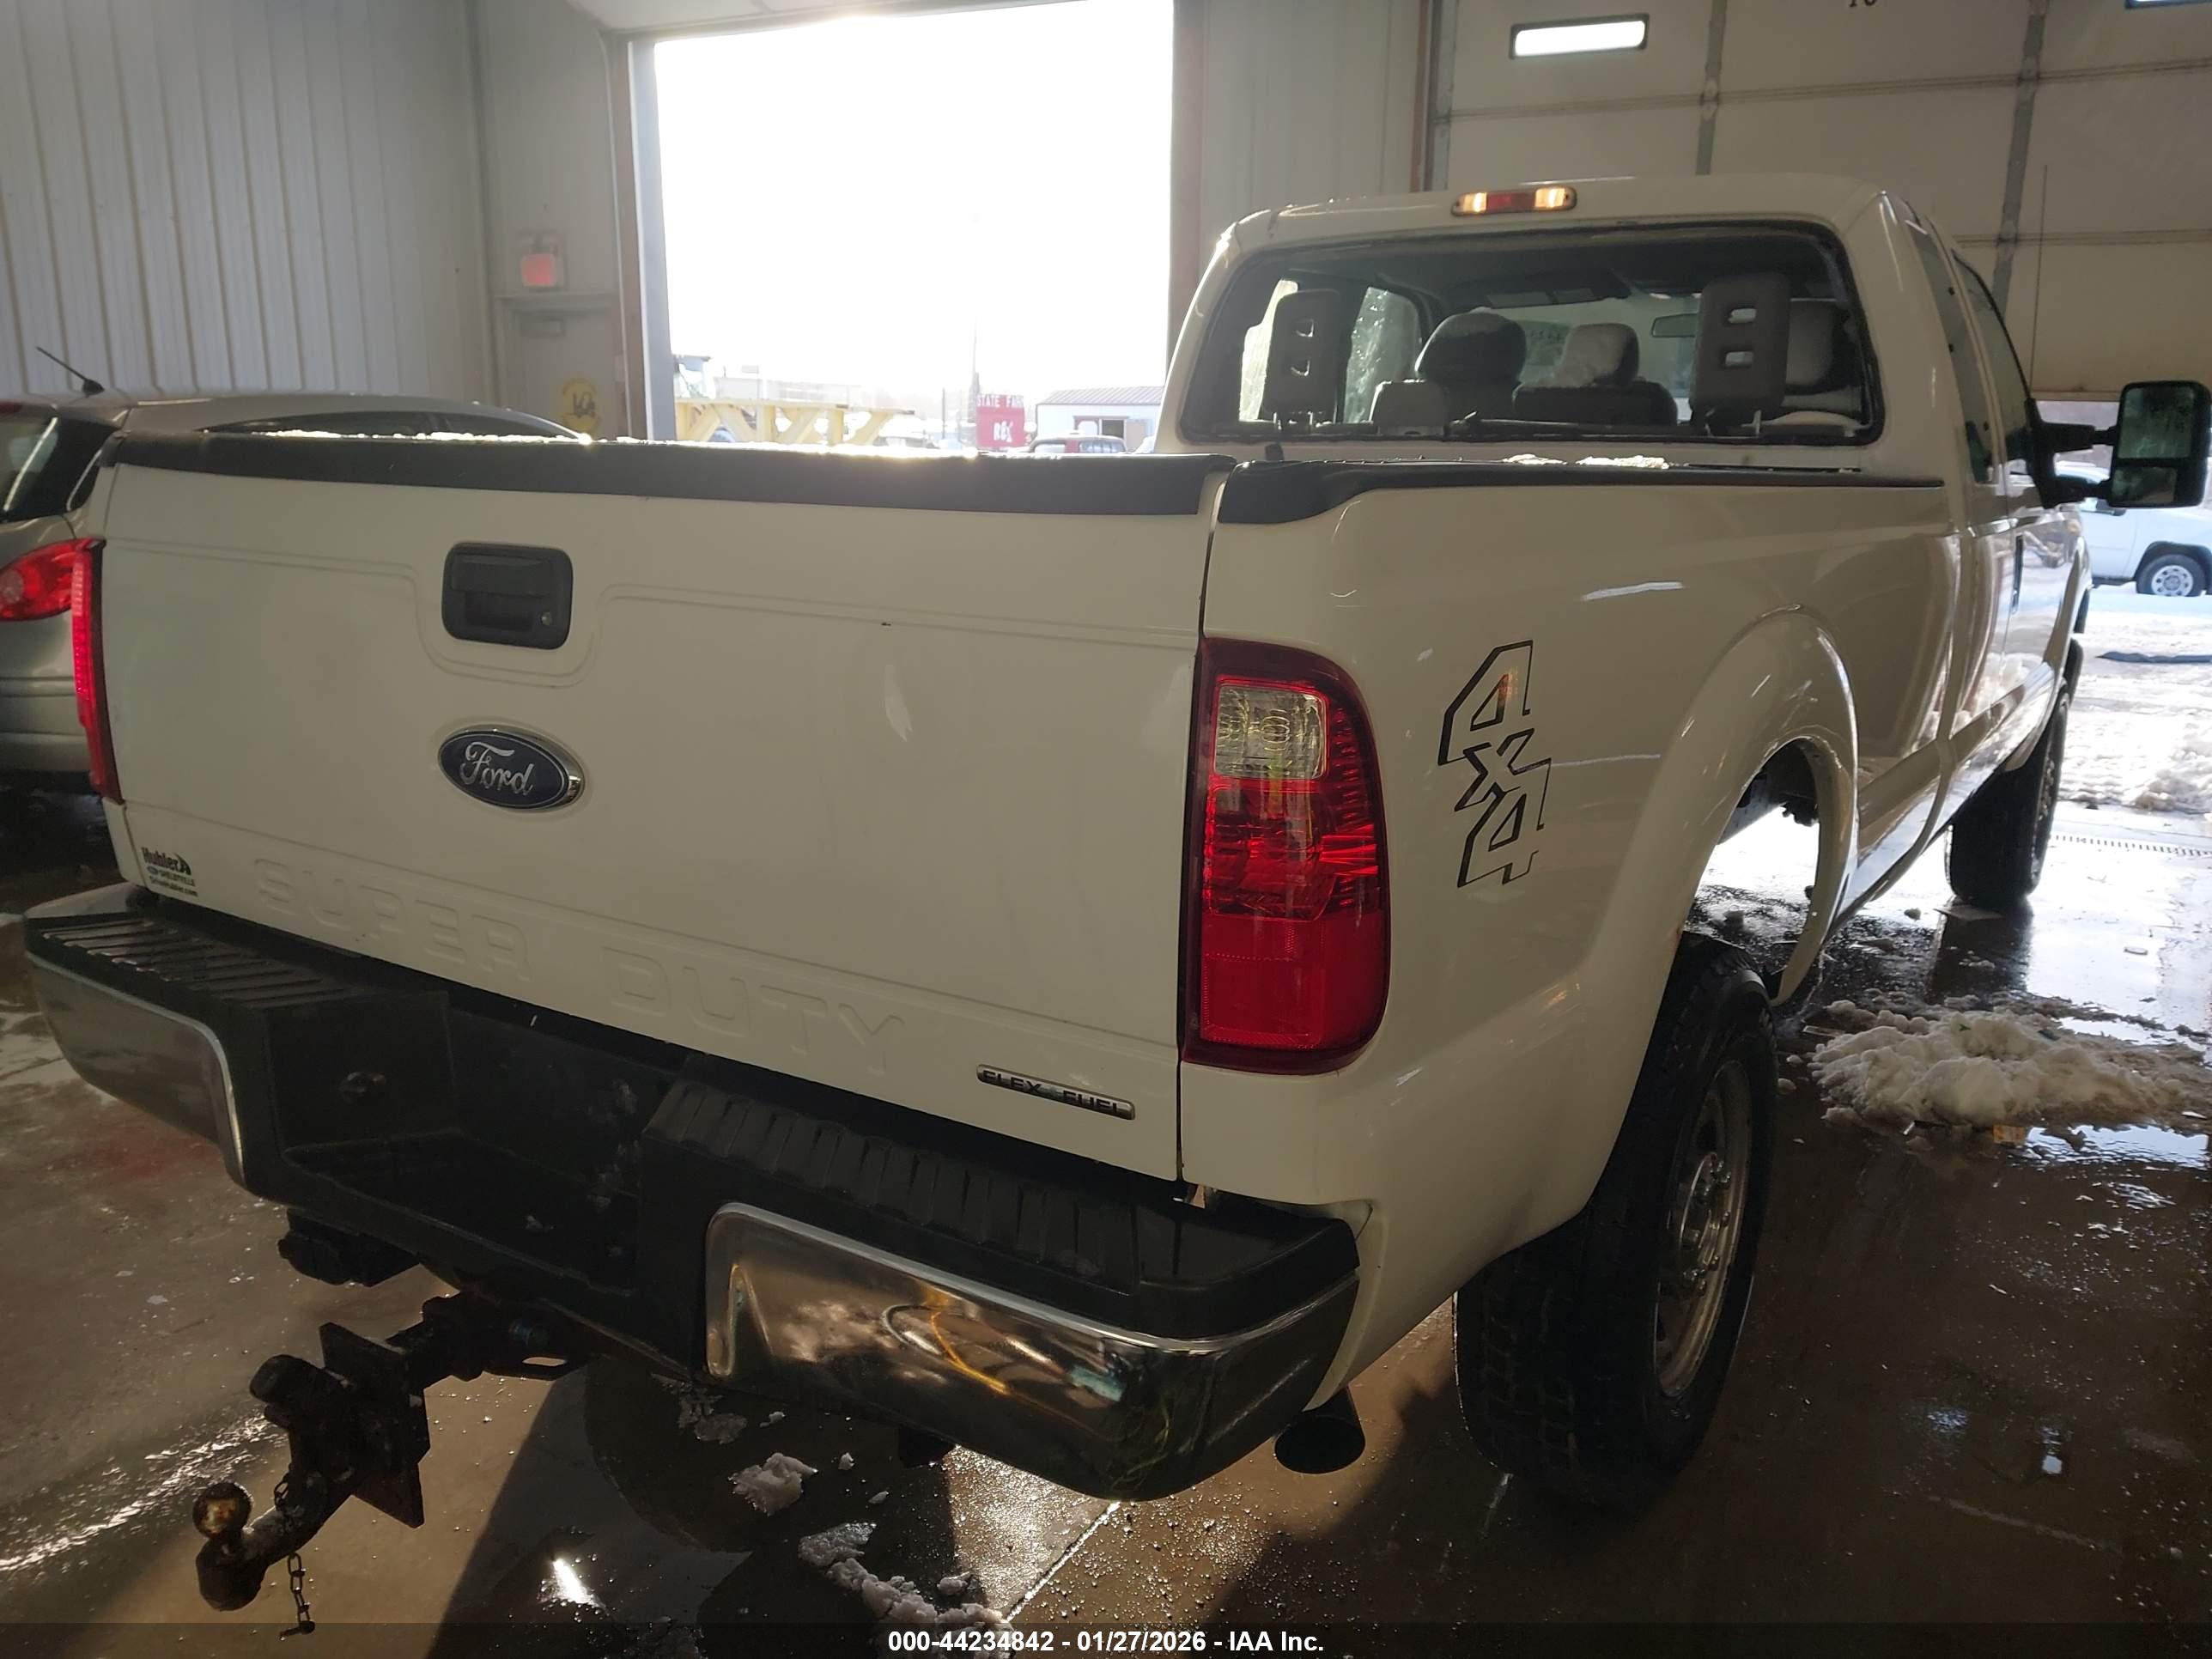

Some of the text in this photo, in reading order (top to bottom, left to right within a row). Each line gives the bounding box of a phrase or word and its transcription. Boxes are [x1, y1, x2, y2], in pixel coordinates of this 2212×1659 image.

[459, 741, 536, 797] Ford
[255, 858, 906, 1076] SUPER DUTY
[982, 1070, 1127, 1117] FLEX FUEL
